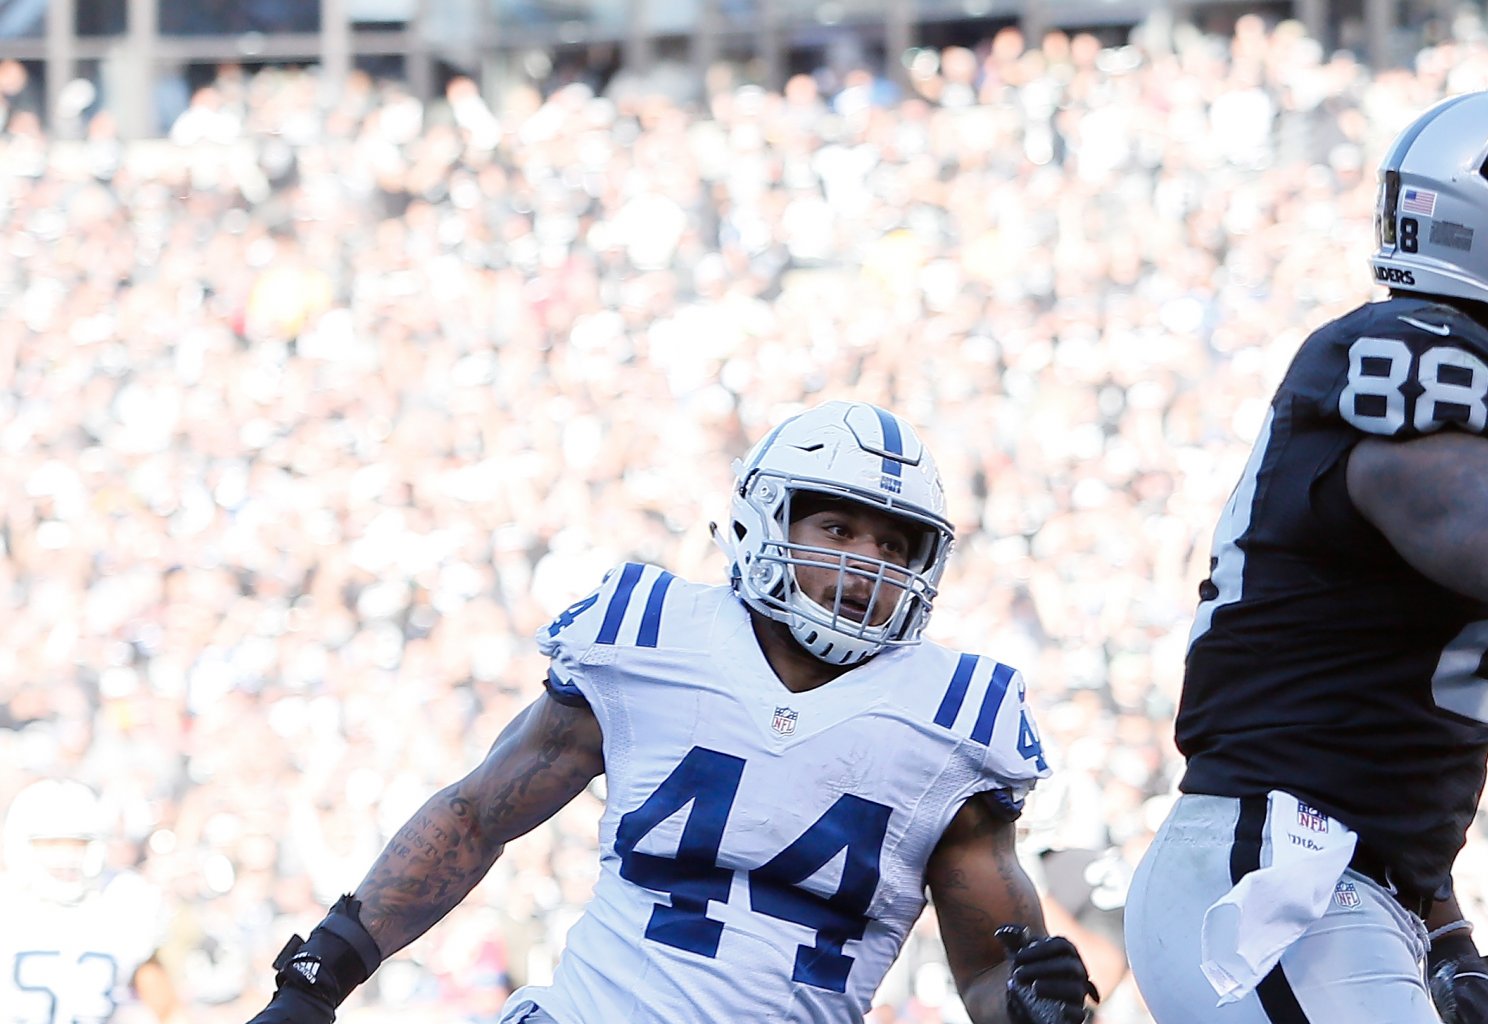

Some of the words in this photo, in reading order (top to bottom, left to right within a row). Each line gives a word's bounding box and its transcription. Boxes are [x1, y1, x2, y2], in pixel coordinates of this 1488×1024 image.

[1400, 217, 1418, 253] 8
[773, 716, 793, 732] NFL
[1299, 812, 1327, 833] NFL
[613, 745, 894, 994] 44
[1337, 891, 1358, 907] NFL
